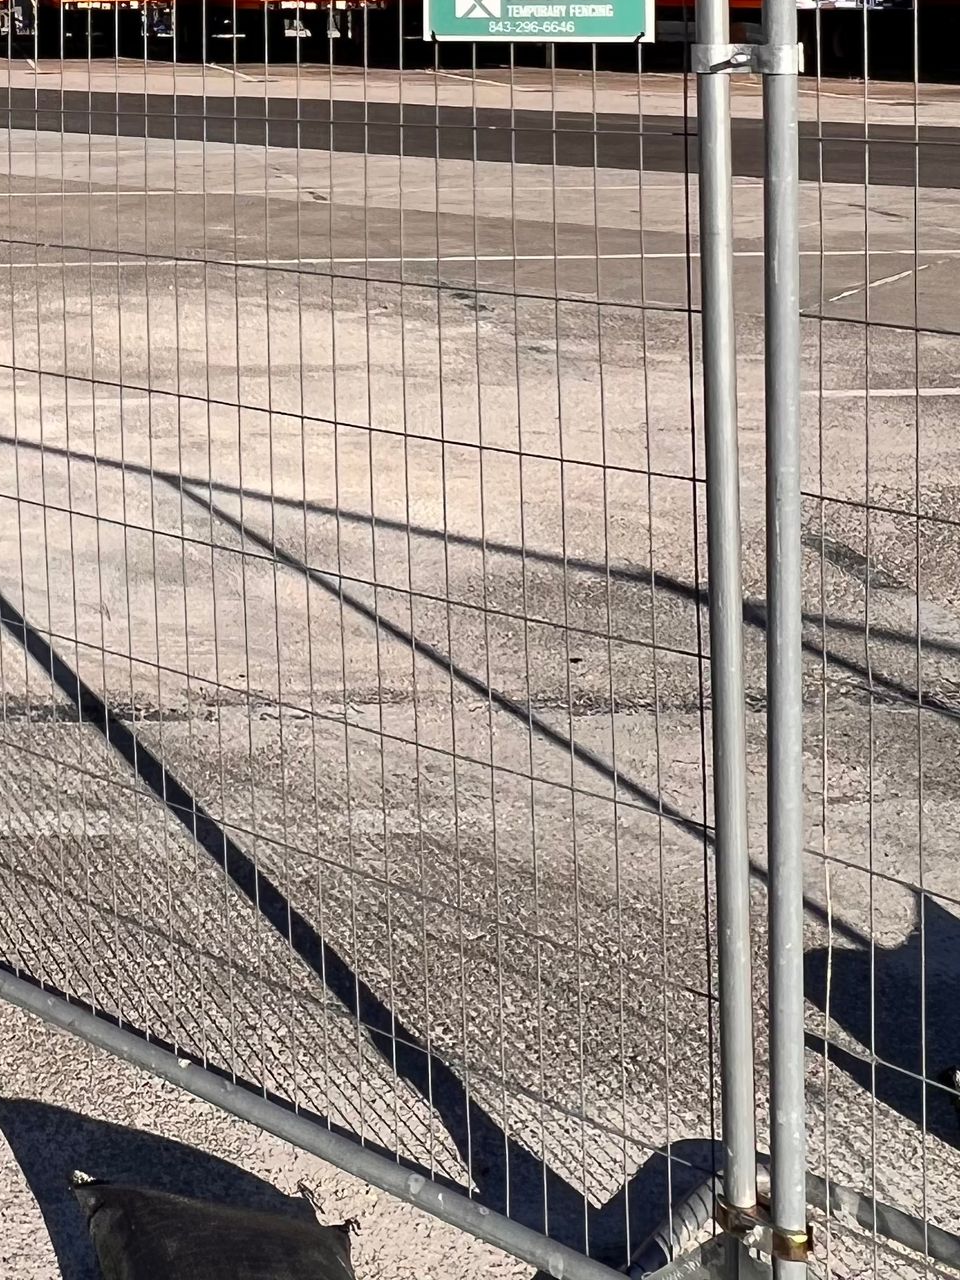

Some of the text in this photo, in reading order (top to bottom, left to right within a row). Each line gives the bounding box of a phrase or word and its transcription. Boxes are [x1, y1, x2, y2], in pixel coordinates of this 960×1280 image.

[507, 3, 614, 18] TEMPORARY FENCING
[488, 21, 575, 33] 843-296-6646
